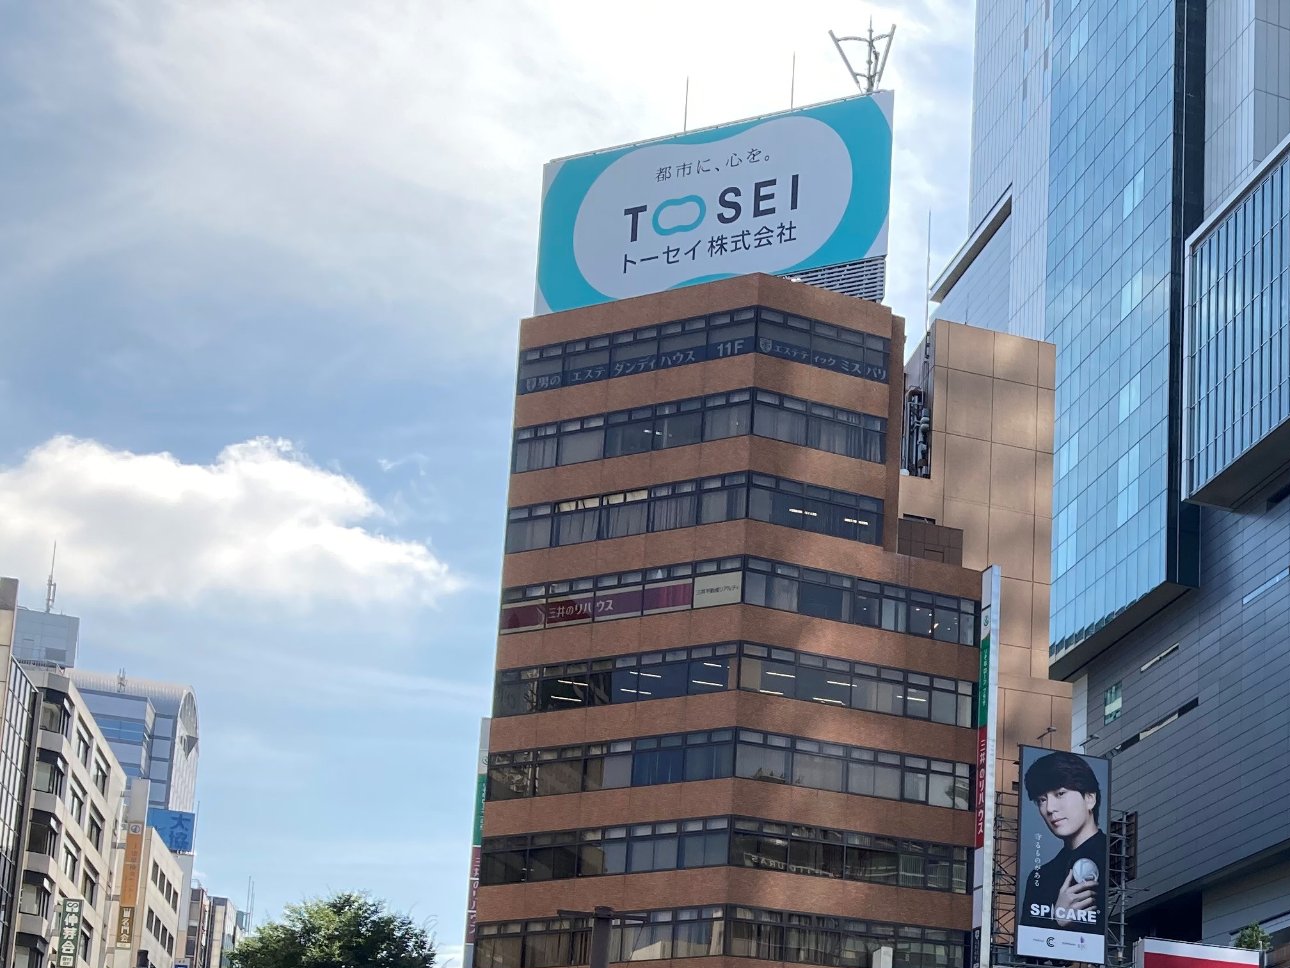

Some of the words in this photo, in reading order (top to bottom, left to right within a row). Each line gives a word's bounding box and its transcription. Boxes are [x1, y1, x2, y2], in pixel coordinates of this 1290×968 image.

[655, 147, 771, 183] 都市に、心を。
[623, 173, 800, 243] TOSEI
[622, 220, 798, 274] トーセイ株式会社
[716, 340, 744, 358] 11F
[548, 599, 614, 619] 三井のリハウス
